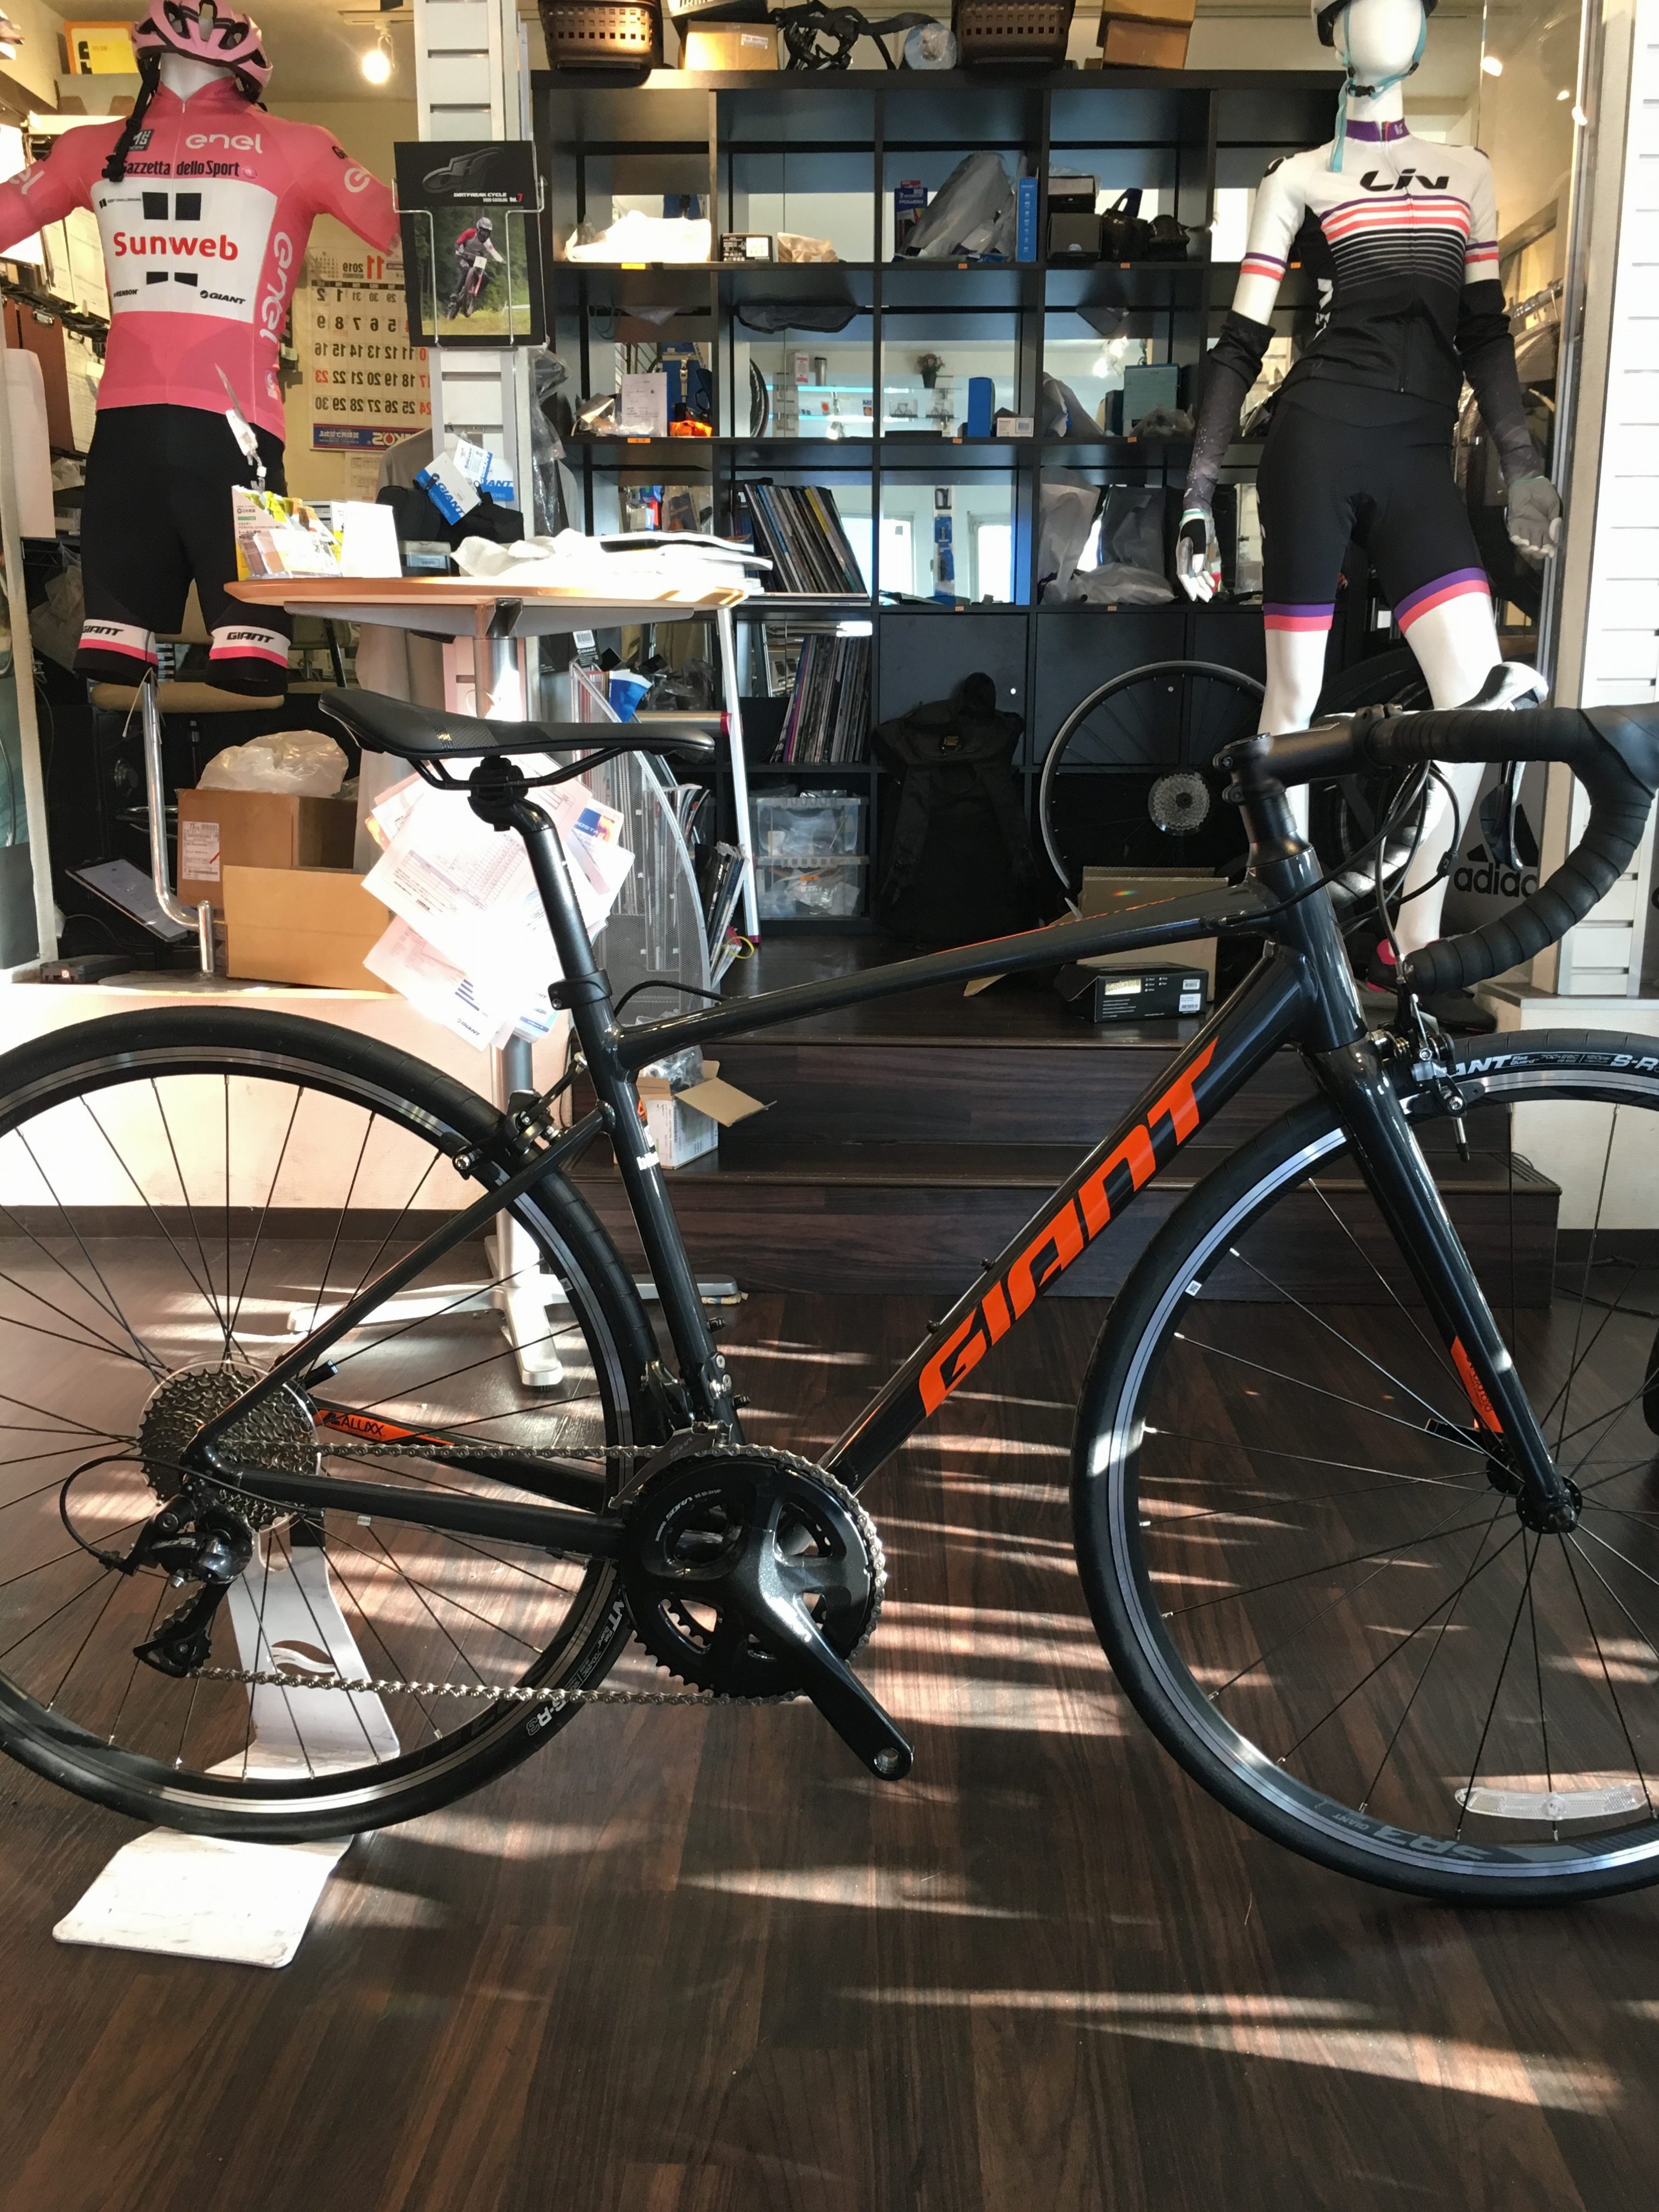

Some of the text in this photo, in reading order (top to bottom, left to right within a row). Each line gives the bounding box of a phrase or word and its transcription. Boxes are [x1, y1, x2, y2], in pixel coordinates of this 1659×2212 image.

[185, 133, 263, 154] enel
[176, 160, 204, 176] dello
[207, 161, 240, 178] Sport
[1360, 168, 1449, 192] Liv
[518, 193, 523, 202] 7
[114, 232, 238, 261] Sunweb
[259, 232, 293, 344] enel
[209, 292, 245, 305] GIANT
[438, 482, 466, 517] GIANT
[227, 632, 275, 643] GIANT
[461, 1022, 480, 1036] GIANT
[1610, 1054, 1659, 1071] S-R
[918, 1036, 1218, 1417] GIANT
[341, 1416, 385, 1436] ALUXX
[666, 1496, 693, 1521] SORA
[1331, 1813, 1370, 1830] GIANT
